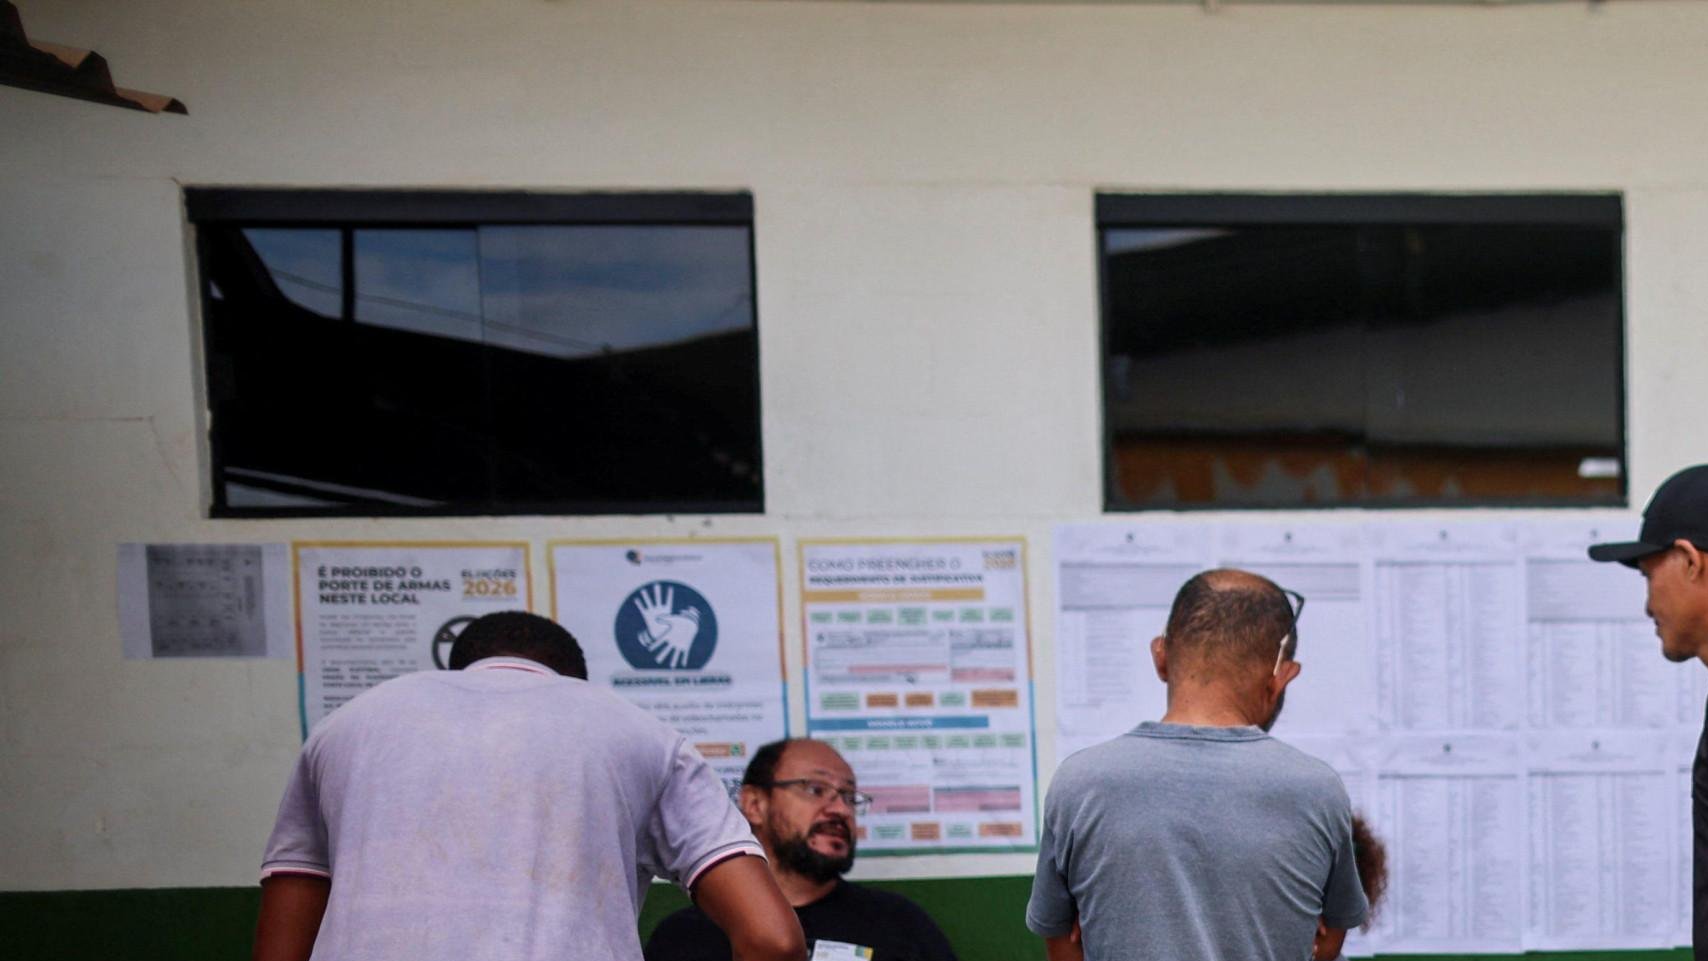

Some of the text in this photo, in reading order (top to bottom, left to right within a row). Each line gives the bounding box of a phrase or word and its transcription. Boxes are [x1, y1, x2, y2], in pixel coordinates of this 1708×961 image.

[318, 565, 422, 578] É PROIBIDO O
[319, 579, 452, 591] PORTE DE ARMAS
[462, 578, 517, 596] 2026
[320, 592, 420, 605] NESTE LOCAL
